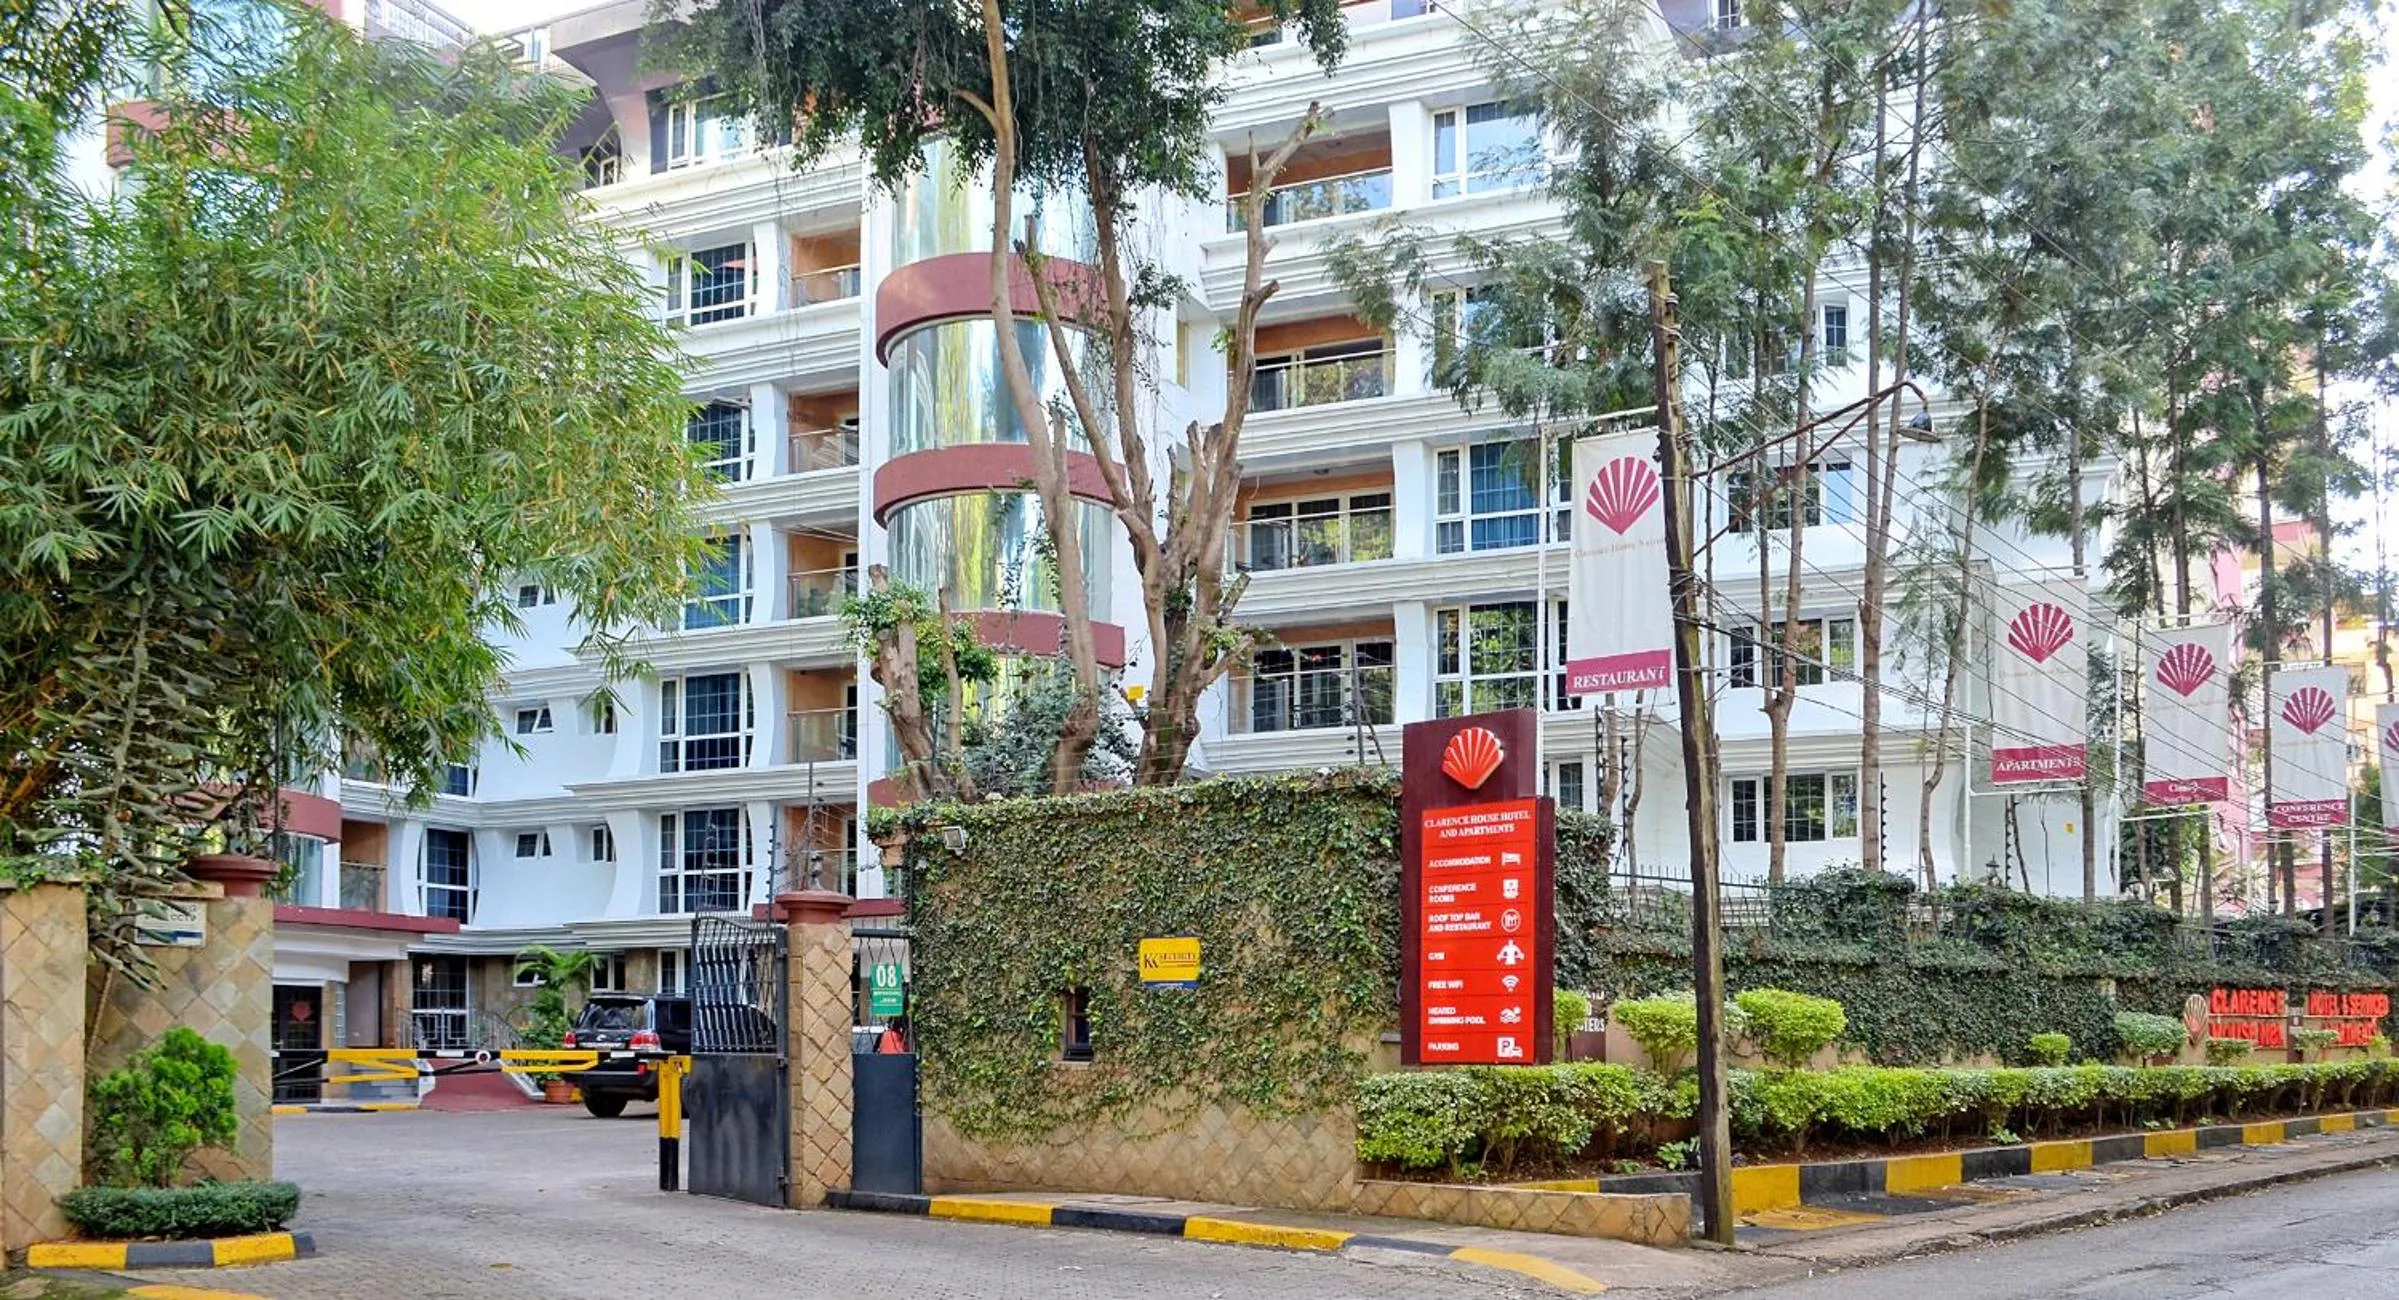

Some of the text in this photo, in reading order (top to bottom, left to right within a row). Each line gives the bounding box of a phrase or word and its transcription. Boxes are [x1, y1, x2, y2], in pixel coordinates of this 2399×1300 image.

[1573, 666, 1666, 689] RESTAURANT
[1996, 756, 2082, 772] APARTMENTS
[1424, 810, 1530, 828] CLARENCE HOUSE HOTEL
[1439, 823, 1515, 838] AND APARTMENTS
[1428, 883, 1476, 894] CONFERENCE
[876, 965, 897, 988] 08
[2211, 989, 2286, 1014] CLARENCE
